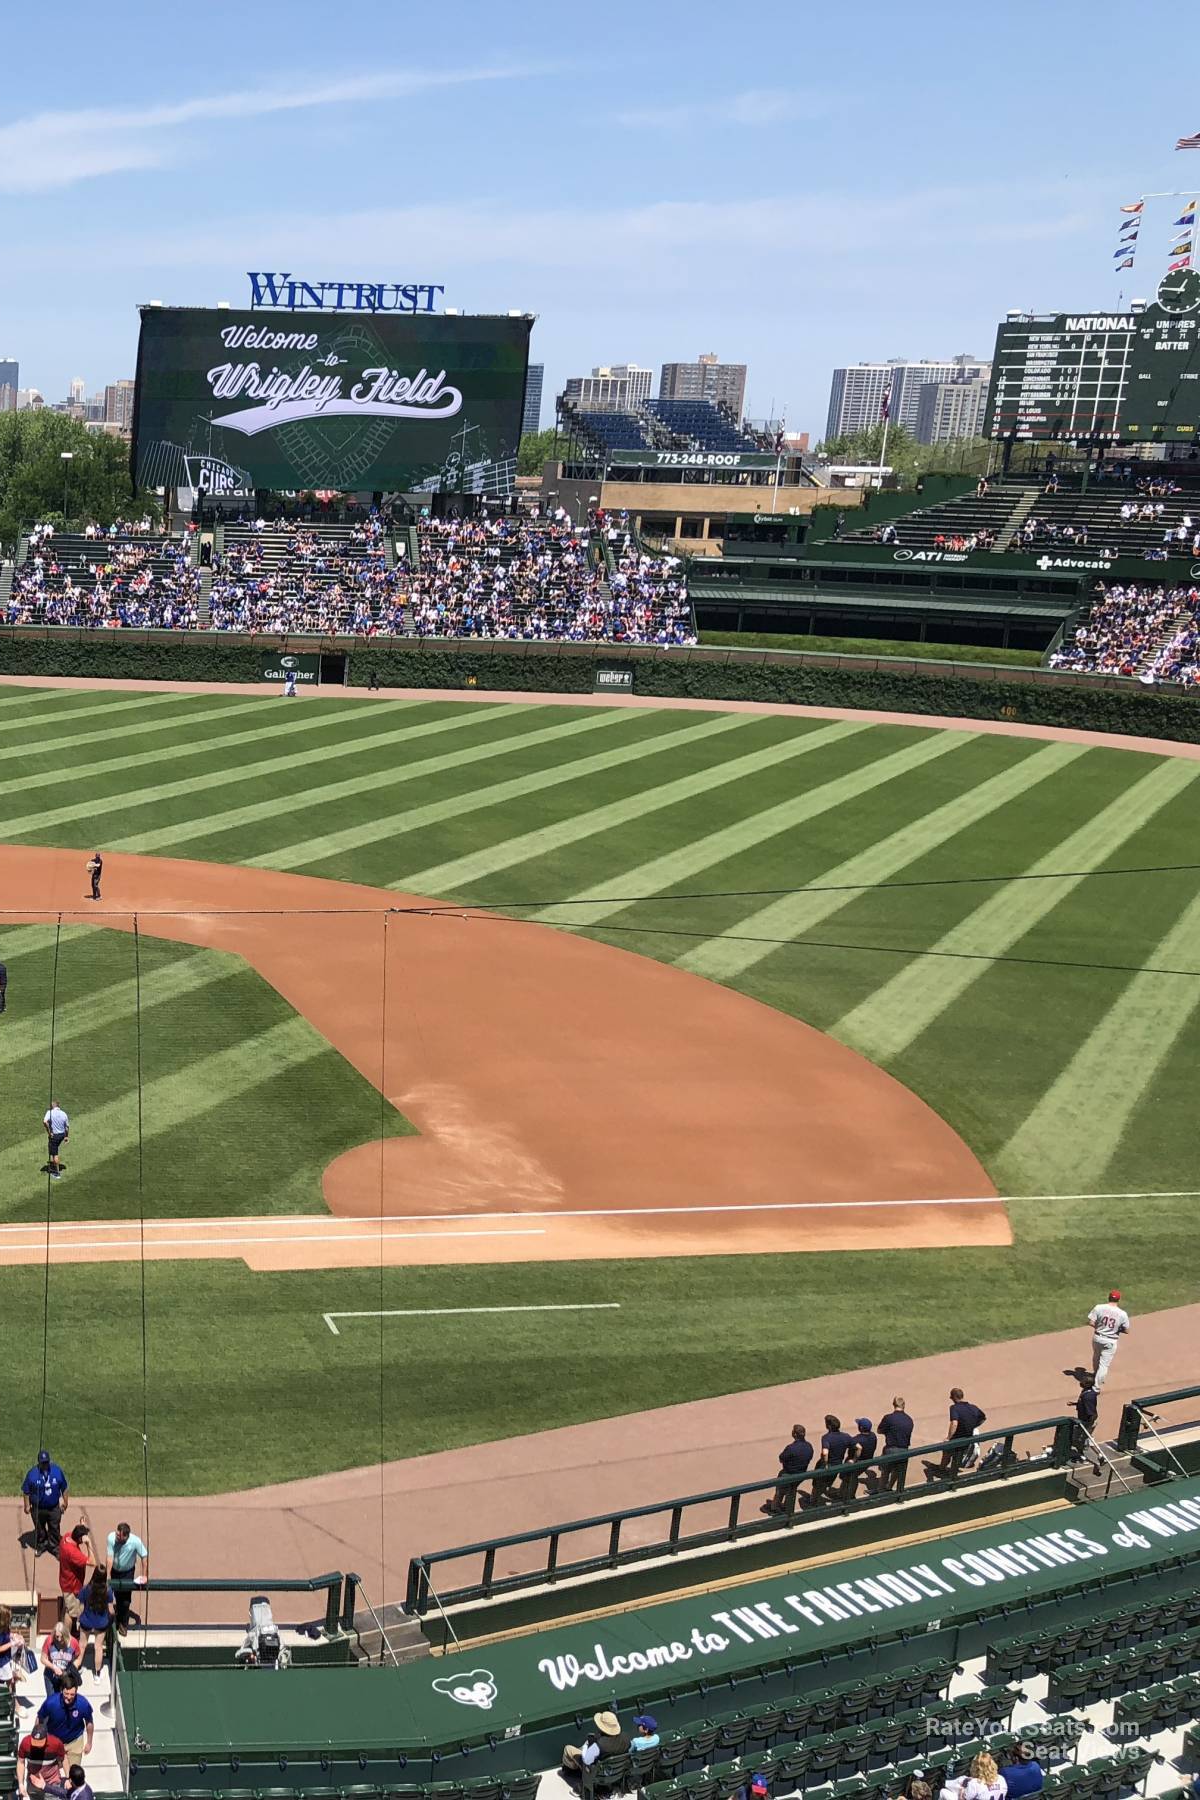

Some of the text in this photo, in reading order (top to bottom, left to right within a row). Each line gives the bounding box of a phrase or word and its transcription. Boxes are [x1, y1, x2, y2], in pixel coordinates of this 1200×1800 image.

[247, 272, 445, 312] WINTRUST
[1065, 317, 1137, 331] NATIONAL
[1155, 320, 1196, 329] UMPIRES
[221, 325, 318, 350] Welcome
[1154, 342, 1189, 350] BATTER
[207, 362, 447, 411] Wrigley Field
[656, 453, 741, 466] 773-248-ROOF
[912, 551, 943, 561] ATI
[1053, 558, 1112, 569] Advocate
[264, 669, 314, 679] Gallher
[600, 671, 623, 683] weber
[1101, 1316, 1117, 1329] 43
[538, 1496, 1200, 1690] Welcome to THE FRIENDLY CONFINES of WRIG
